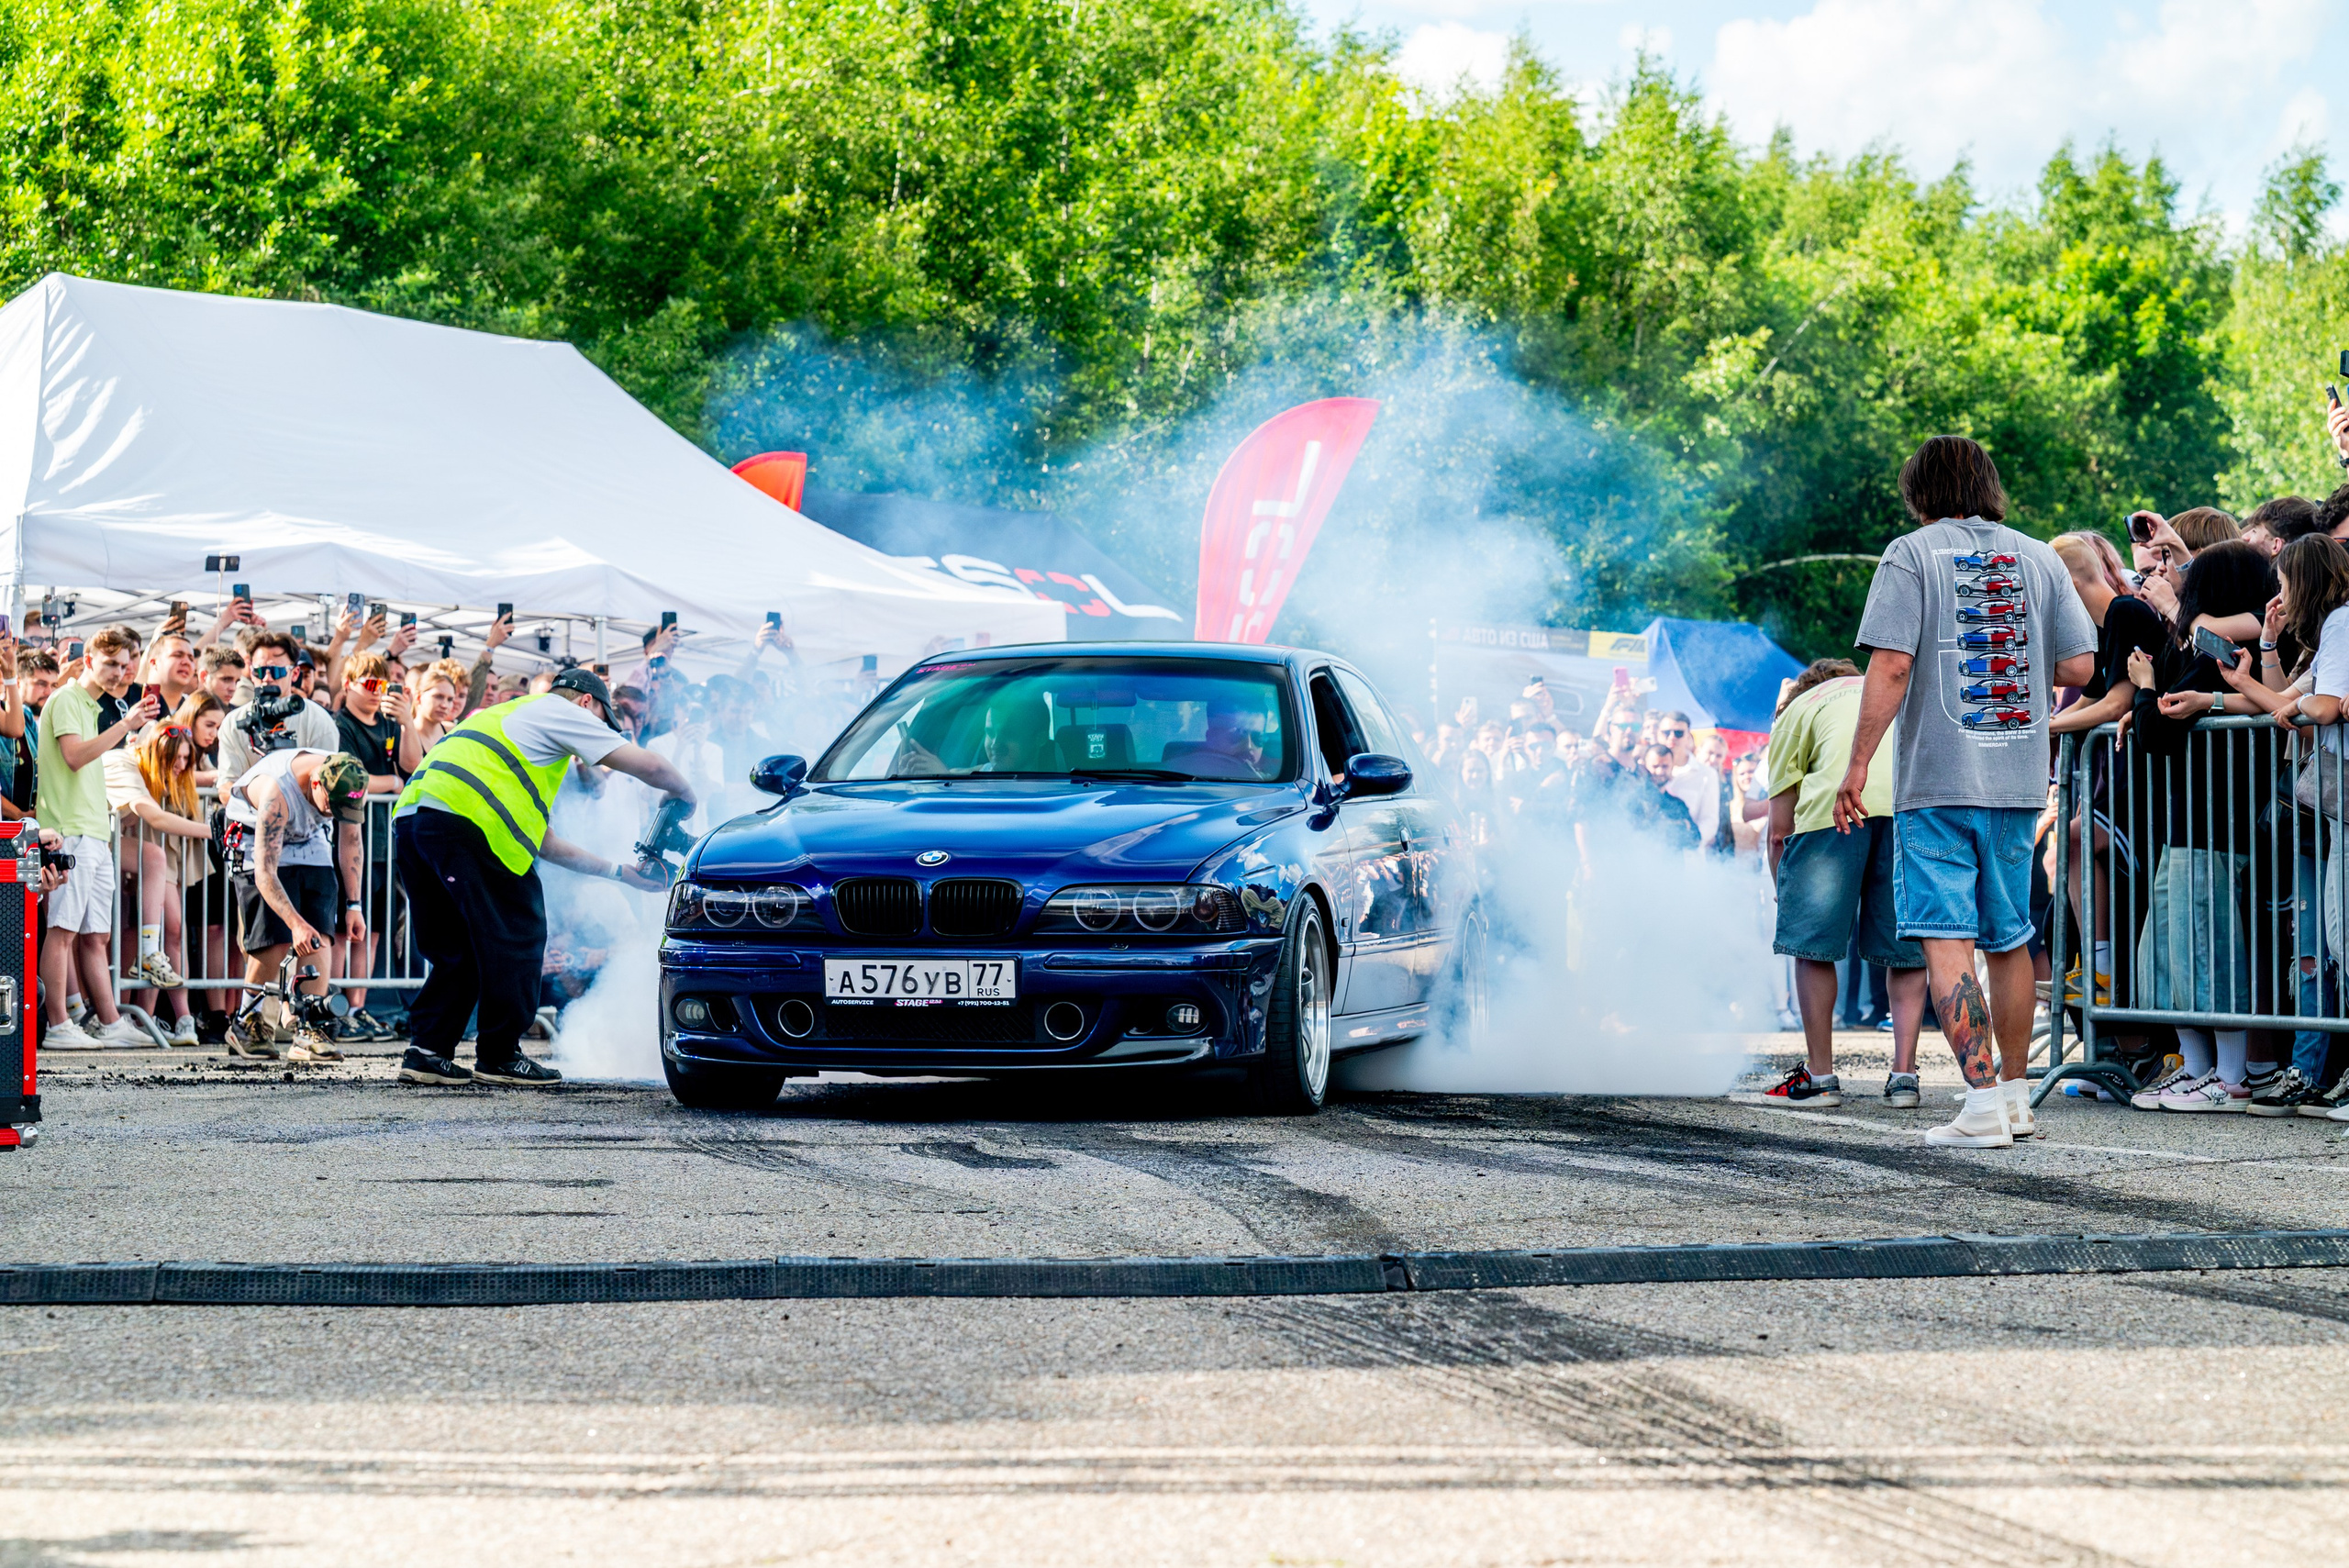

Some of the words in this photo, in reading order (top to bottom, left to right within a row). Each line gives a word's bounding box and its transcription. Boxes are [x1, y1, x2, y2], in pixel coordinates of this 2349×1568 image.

[886, 554, 1184, 622] SOL
[1463, 628, 1497, 645] АВТО
[1498, 629, 1517, 646] ИЗ
[1520, 630, 1549, 649] США
[973, 963, 1003, 986] 77
[896, 998, 930, 1007] STAGE
[976, 988, 1000, 996] RUS
